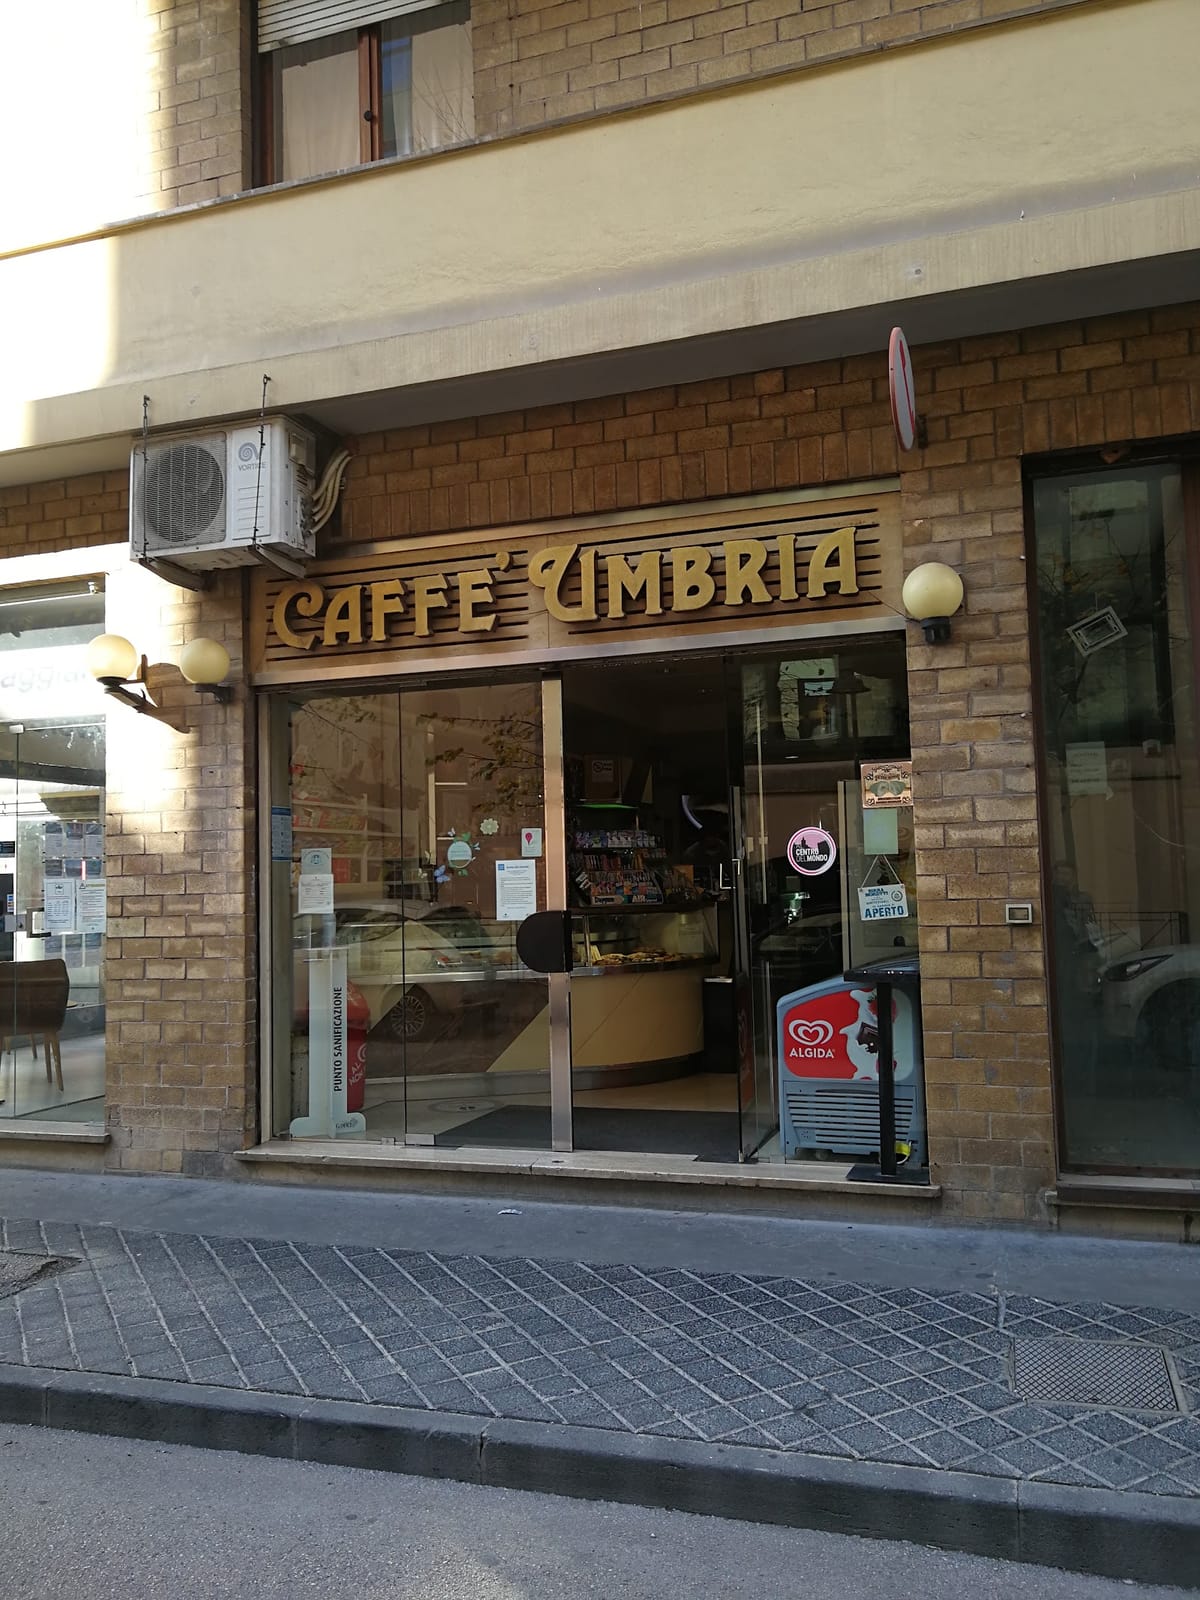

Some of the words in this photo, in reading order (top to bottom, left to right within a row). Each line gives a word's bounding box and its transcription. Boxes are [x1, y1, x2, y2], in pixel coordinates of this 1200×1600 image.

[527, 526, 861, 623] UMBRIA
[795, 848, 820, 856] CENTRO
[865, 905, 904, 918] APERTO
[333, 986, 343, 1057] SANIFICAZIONE
[789, 1047, 834, 1059] ALGIDA
[333, 1059, 343, 1092] PUNTO
